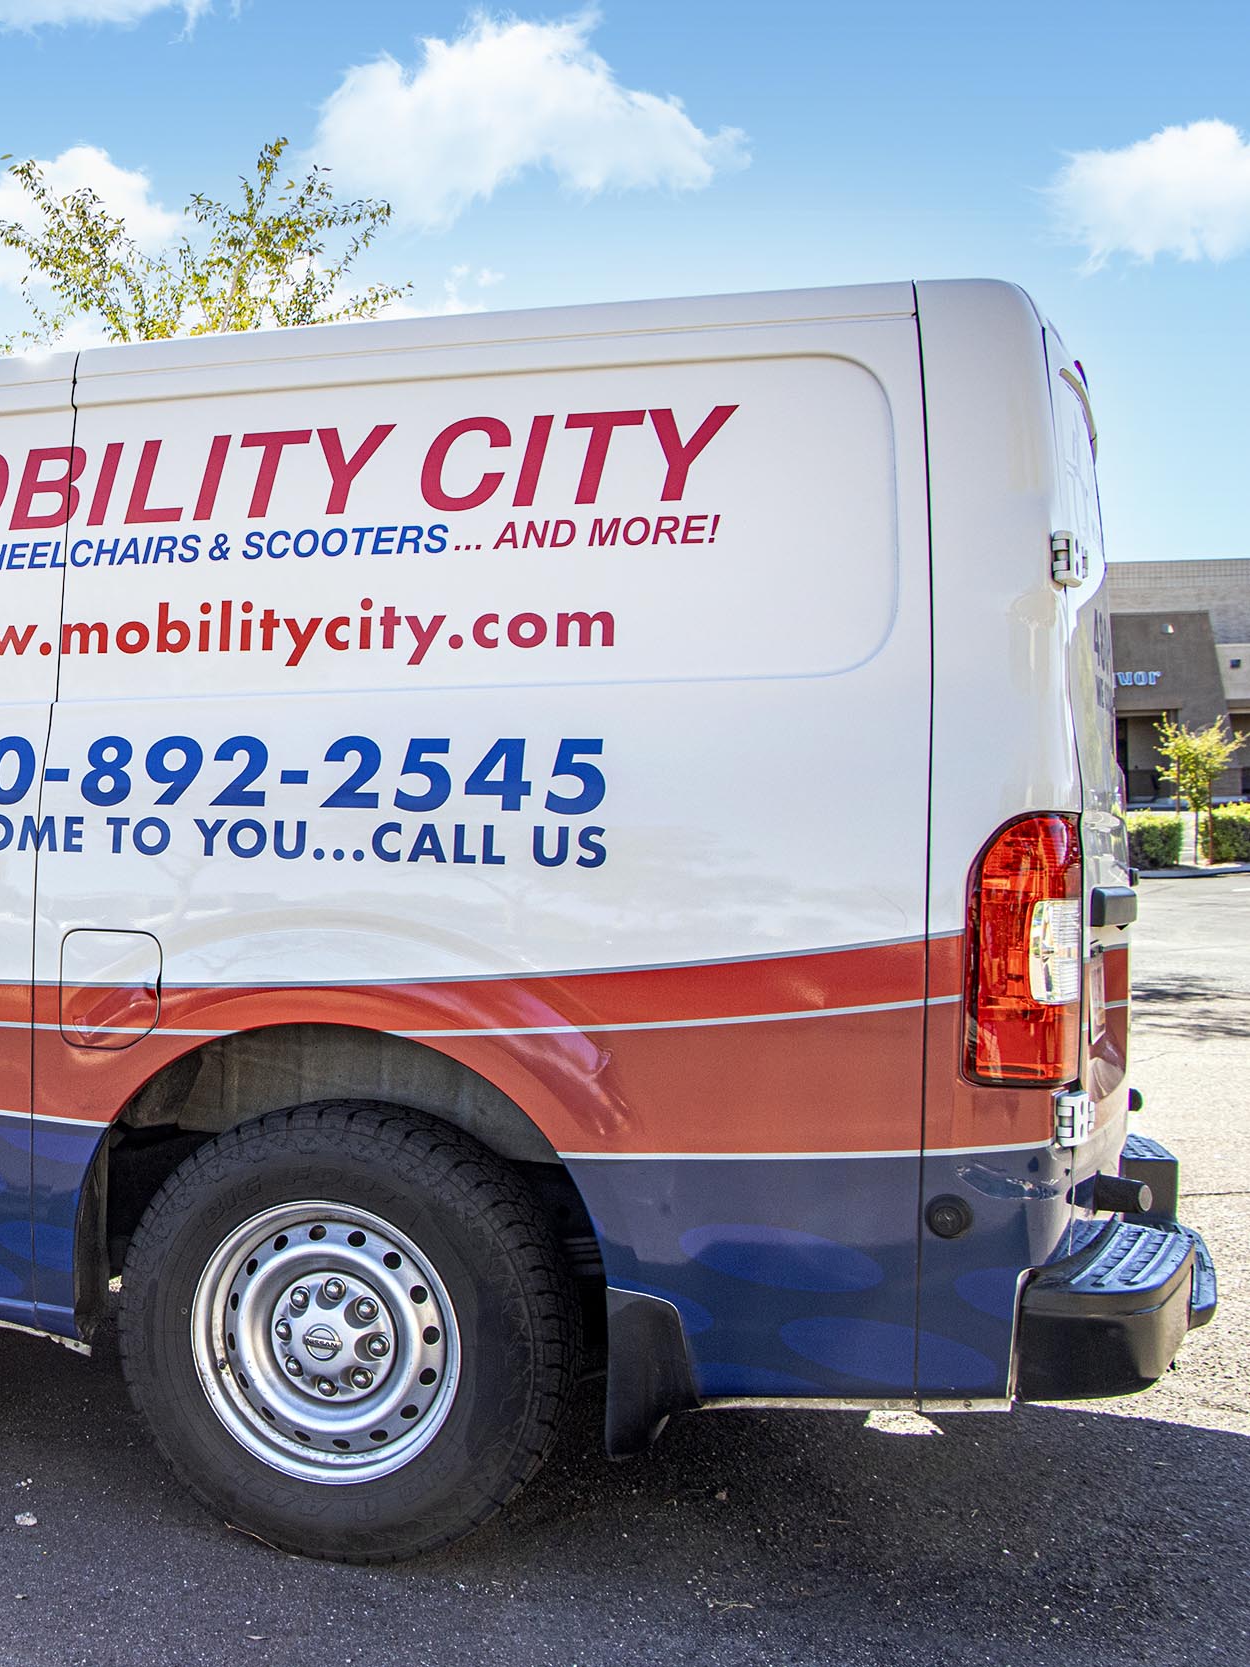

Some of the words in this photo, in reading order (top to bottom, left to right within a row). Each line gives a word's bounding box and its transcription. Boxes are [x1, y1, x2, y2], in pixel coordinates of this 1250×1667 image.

[420, 404, 738, 512] CITY
[208, 533, 231, 561] &
[493, 519, 577, 550] AND
[588, 514, 721, 548] MORE!
[106, 816, 171, 855] TO
[533, 825, 607, 868] US
[305, 1337, 338, 1348] NISSAN
